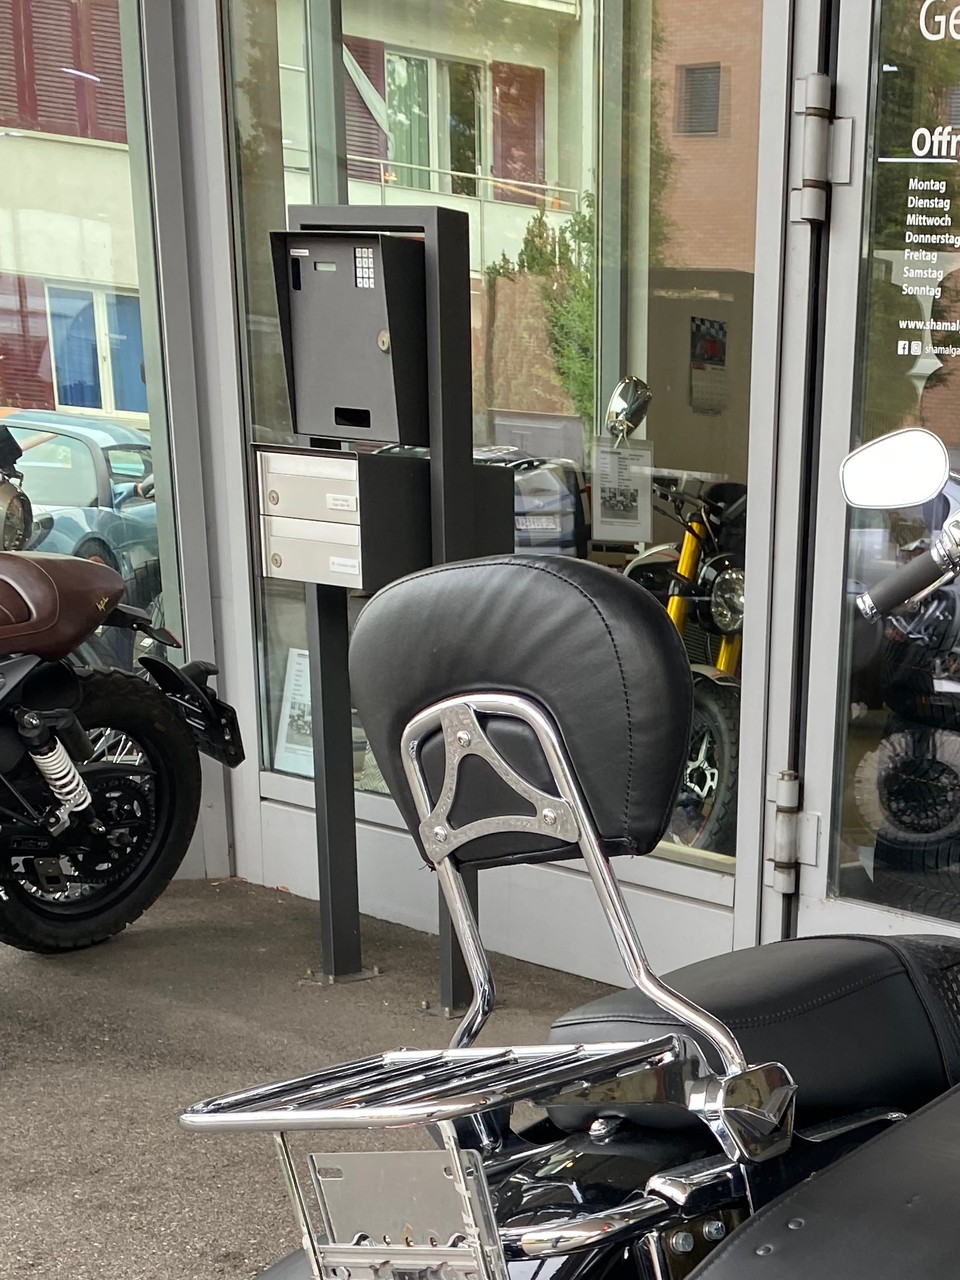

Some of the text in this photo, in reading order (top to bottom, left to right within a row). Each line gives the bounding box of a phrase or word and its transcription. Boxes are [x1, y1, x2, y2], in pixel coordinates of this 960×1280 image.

[908, 178, 947, 192] Montag
[907, 196, 951, 212] Dienstag
[906, 214, 952, 227] Mittwoch
[905, 231, 960, 248] Donnerstag
[904, 249, 938, 263] Freitag
[903, 266, 944, 281] Samstag
[901, 284, 942, 299] Sonntag
